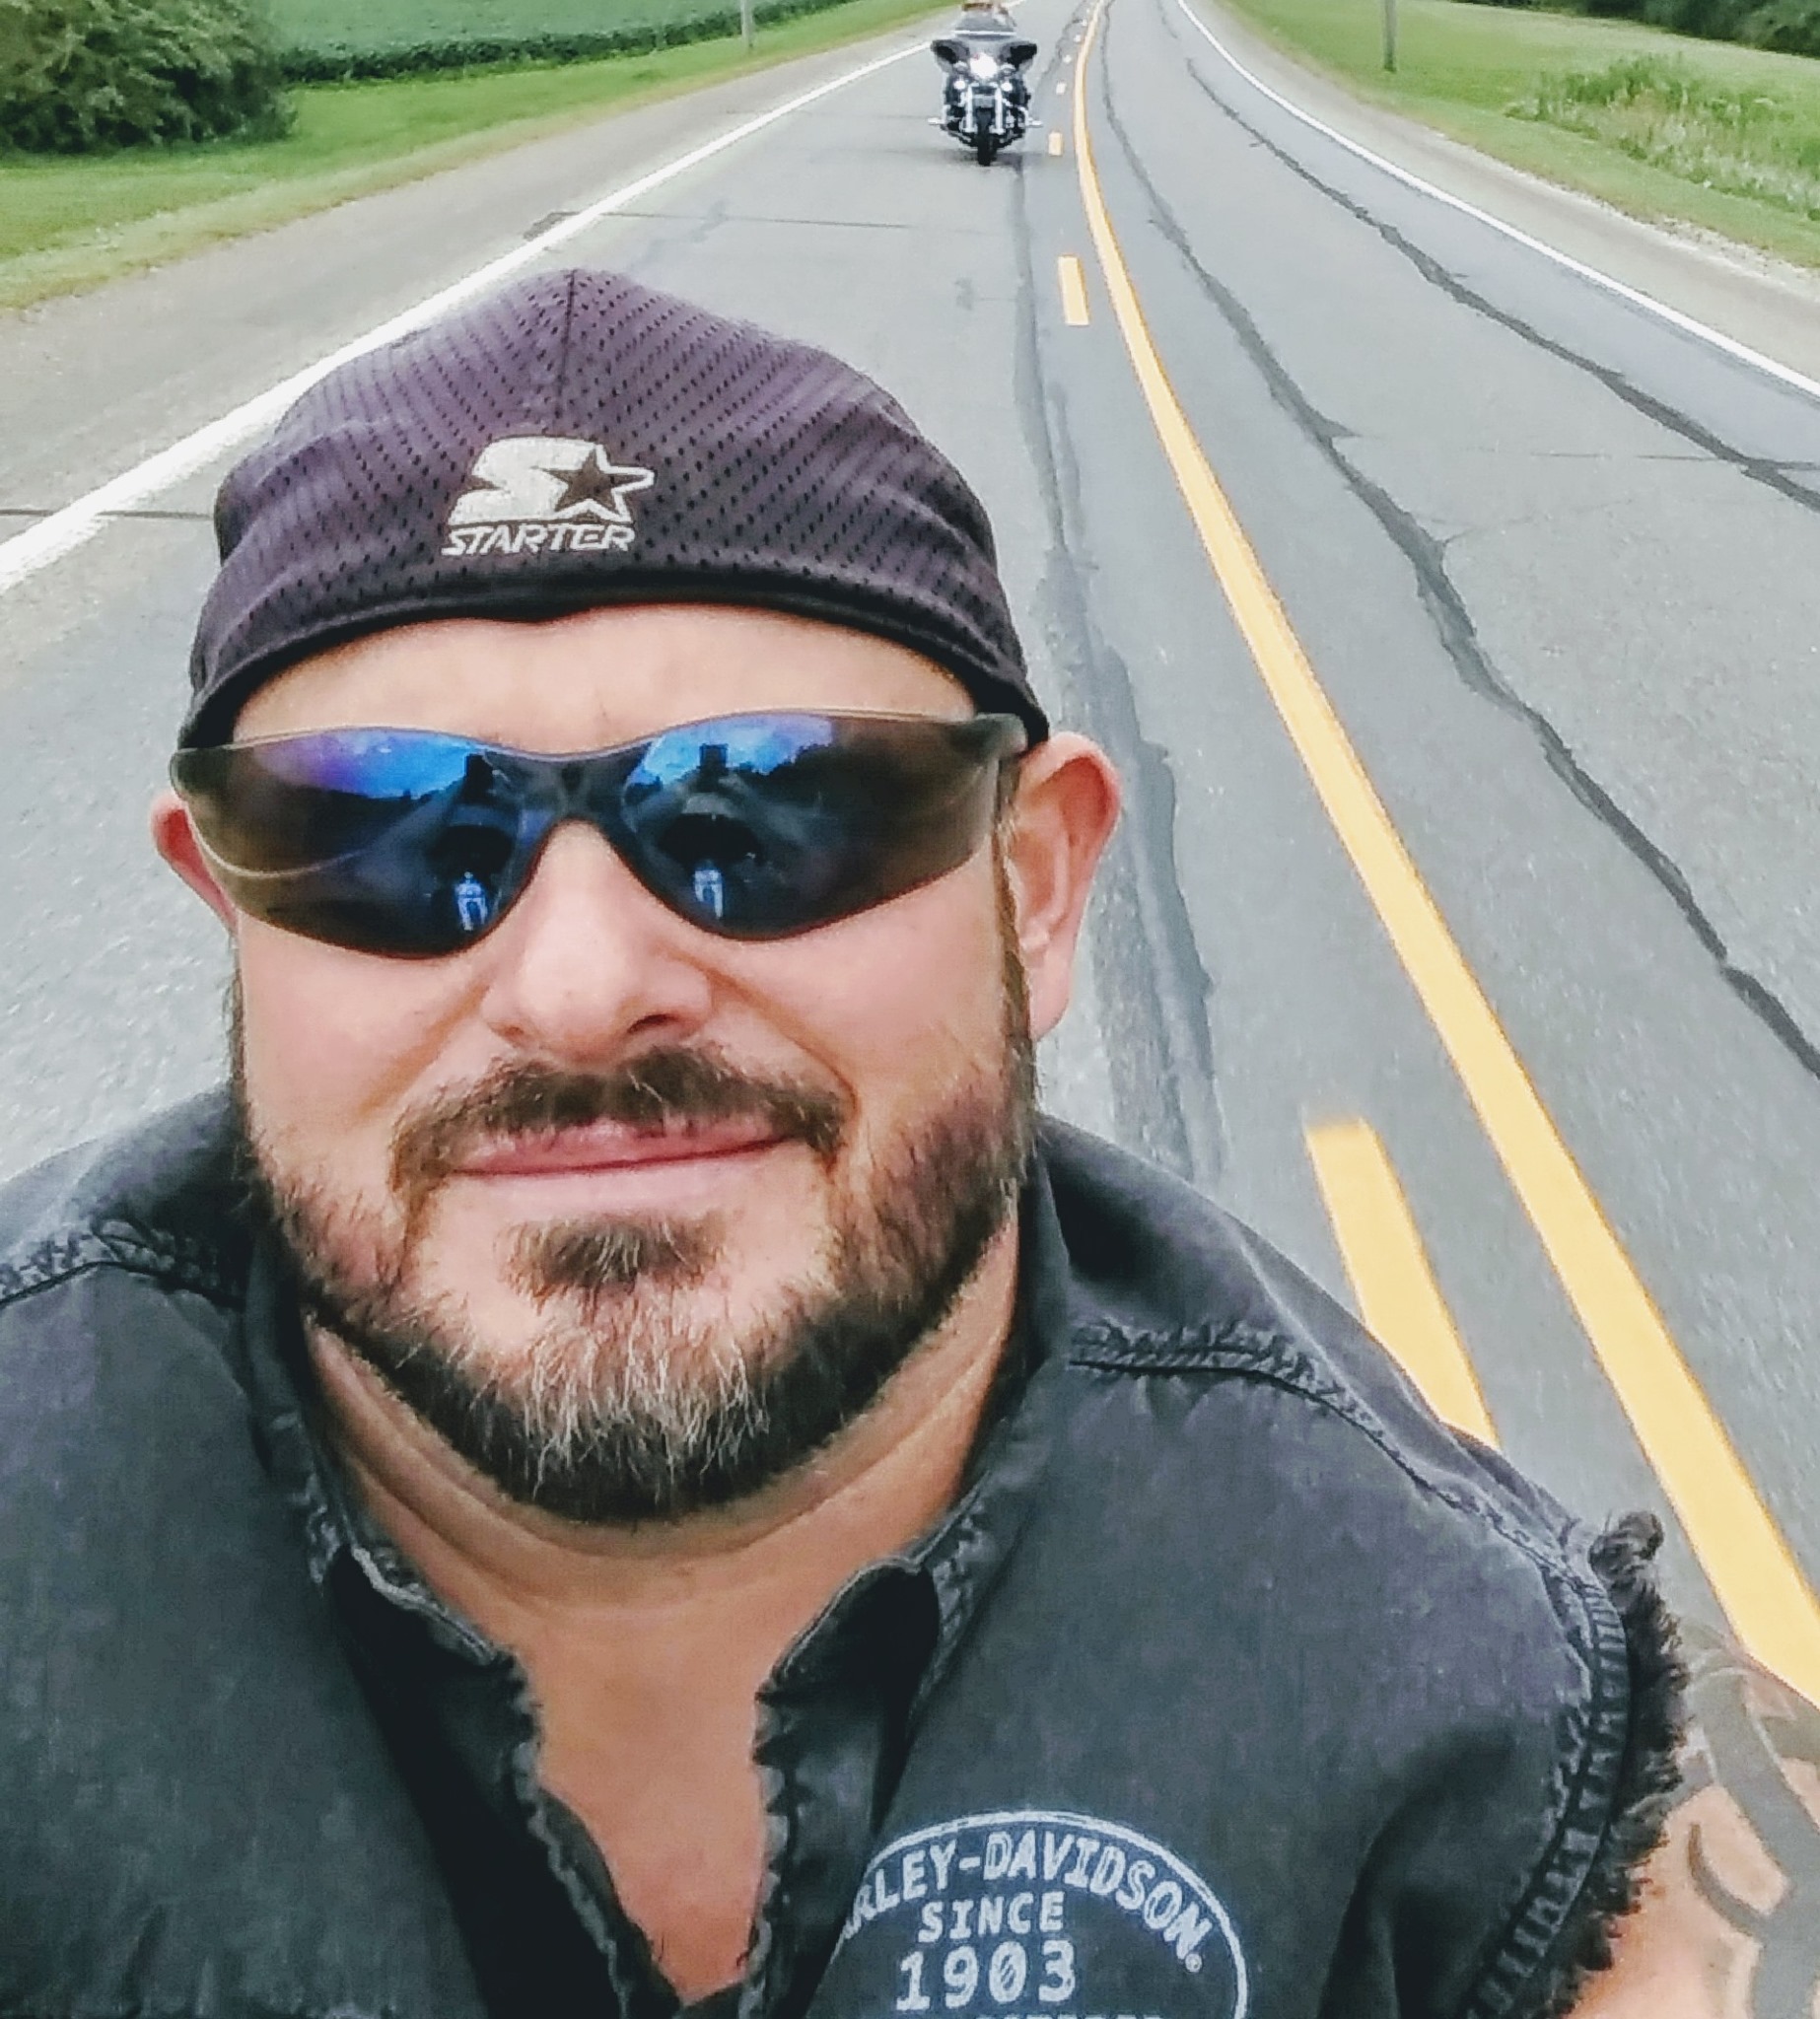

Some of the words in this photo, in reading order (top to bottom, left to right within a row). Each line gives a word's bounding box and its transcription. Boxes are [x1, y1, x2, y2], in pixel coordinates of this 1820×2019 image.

[442, 524, 636, 556] STARTER
[918, 1892, 1065, 1943] SINCE
[896, 1940, 1077, 2010] 1903
